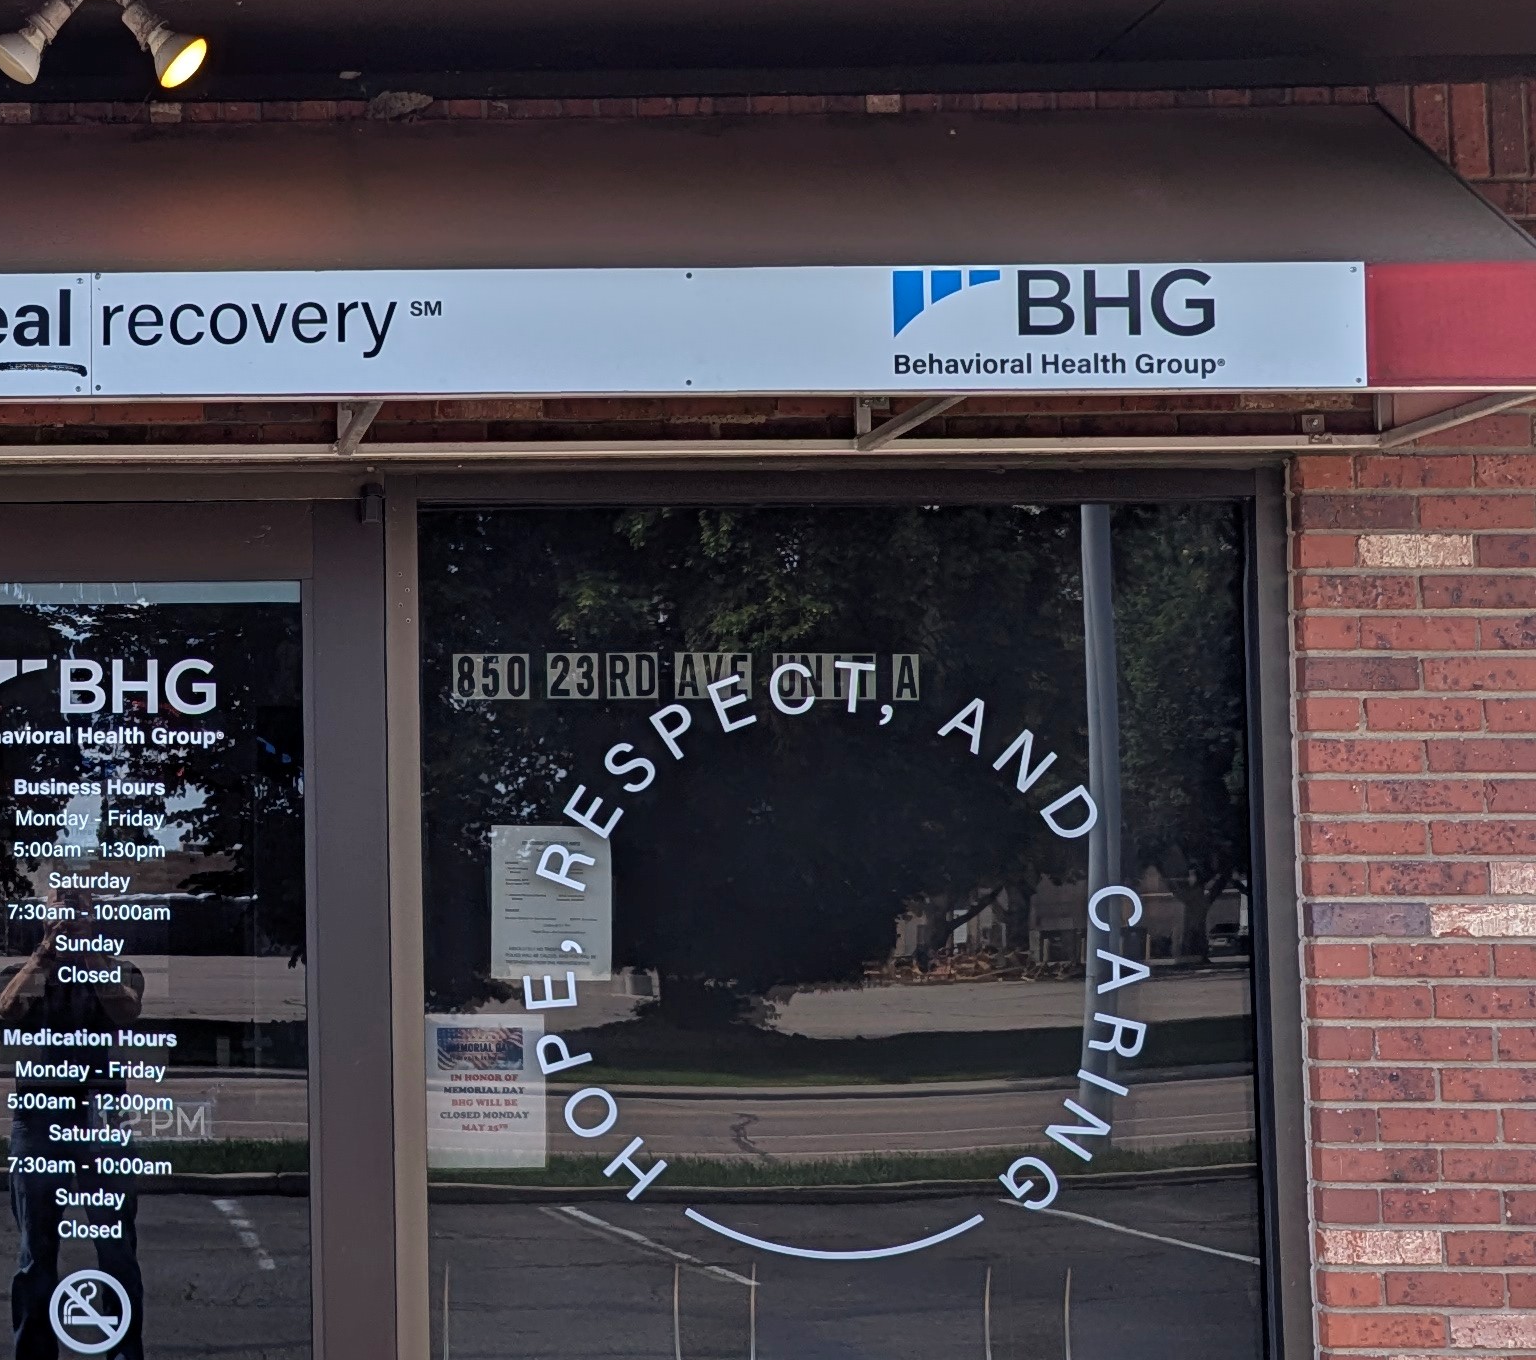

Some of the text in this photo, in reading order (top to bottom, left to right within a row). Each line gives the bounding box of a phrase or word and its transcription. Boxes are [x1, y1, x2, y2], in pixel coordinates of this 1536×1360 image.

[1017, 268, 1216, 337] BHG
[894, 352, 1032, 375] Behavioral
[1041, 352, 1126, 375] Health
[457, 654, 526, 698] 850
[677, 653, 749, 698] AVE
[776, 654, 874, 698] UNIT
[895, 655, 918, 698] A
[61, 658, 216, 715] BHG
[77, 726, 145, 745] Health
[14, 778, 166, 796] Business Hours
[16, 809, 90, 831] Monday
[108, 809, 165, 831] Friday
[13, 841, 81, 858] 5:00am
[100, 841, 166, 862] 1:30pm
[49, 871, 131, 893] Saturday
[8, 904, 75, 920] 7:30am
[94, 904, 171, 921] 10:00am
[55, 934, 124, 956] Sunday
[524, 660, 1151, 1211] HOPE, RESPECT, AND CARING
[57, 965, 121, 984] Closed
[3, 1028, 178, 1047] Medication Hours
[15, 1060, 90, 1082] Monday
[109, 1061, 166, 1083] Friday
[450, 1074, 519, 1082] IN HONOR OF
[443, 1086, 525, 1095] MEMORIAL DAY
[7, 1093, 76, 1110] 5:00am
[95, 1093, 173, 1114] 12:00pm
[451, 1098, 518, 1107] BHG WILL BE
[439, 1111, 530, 1120] CLOSED MONDAY
[49, 1124, 132, 1146] Saturday
[461, 1123, 485, 1132] MAY
[7, 1156, 76, 1174] 7:30am
[95, 1157, 172, 1175] 10:00am
[55, 1188, 125, 1210] Sunday
[58, 1220, 122, 1239] Closed
